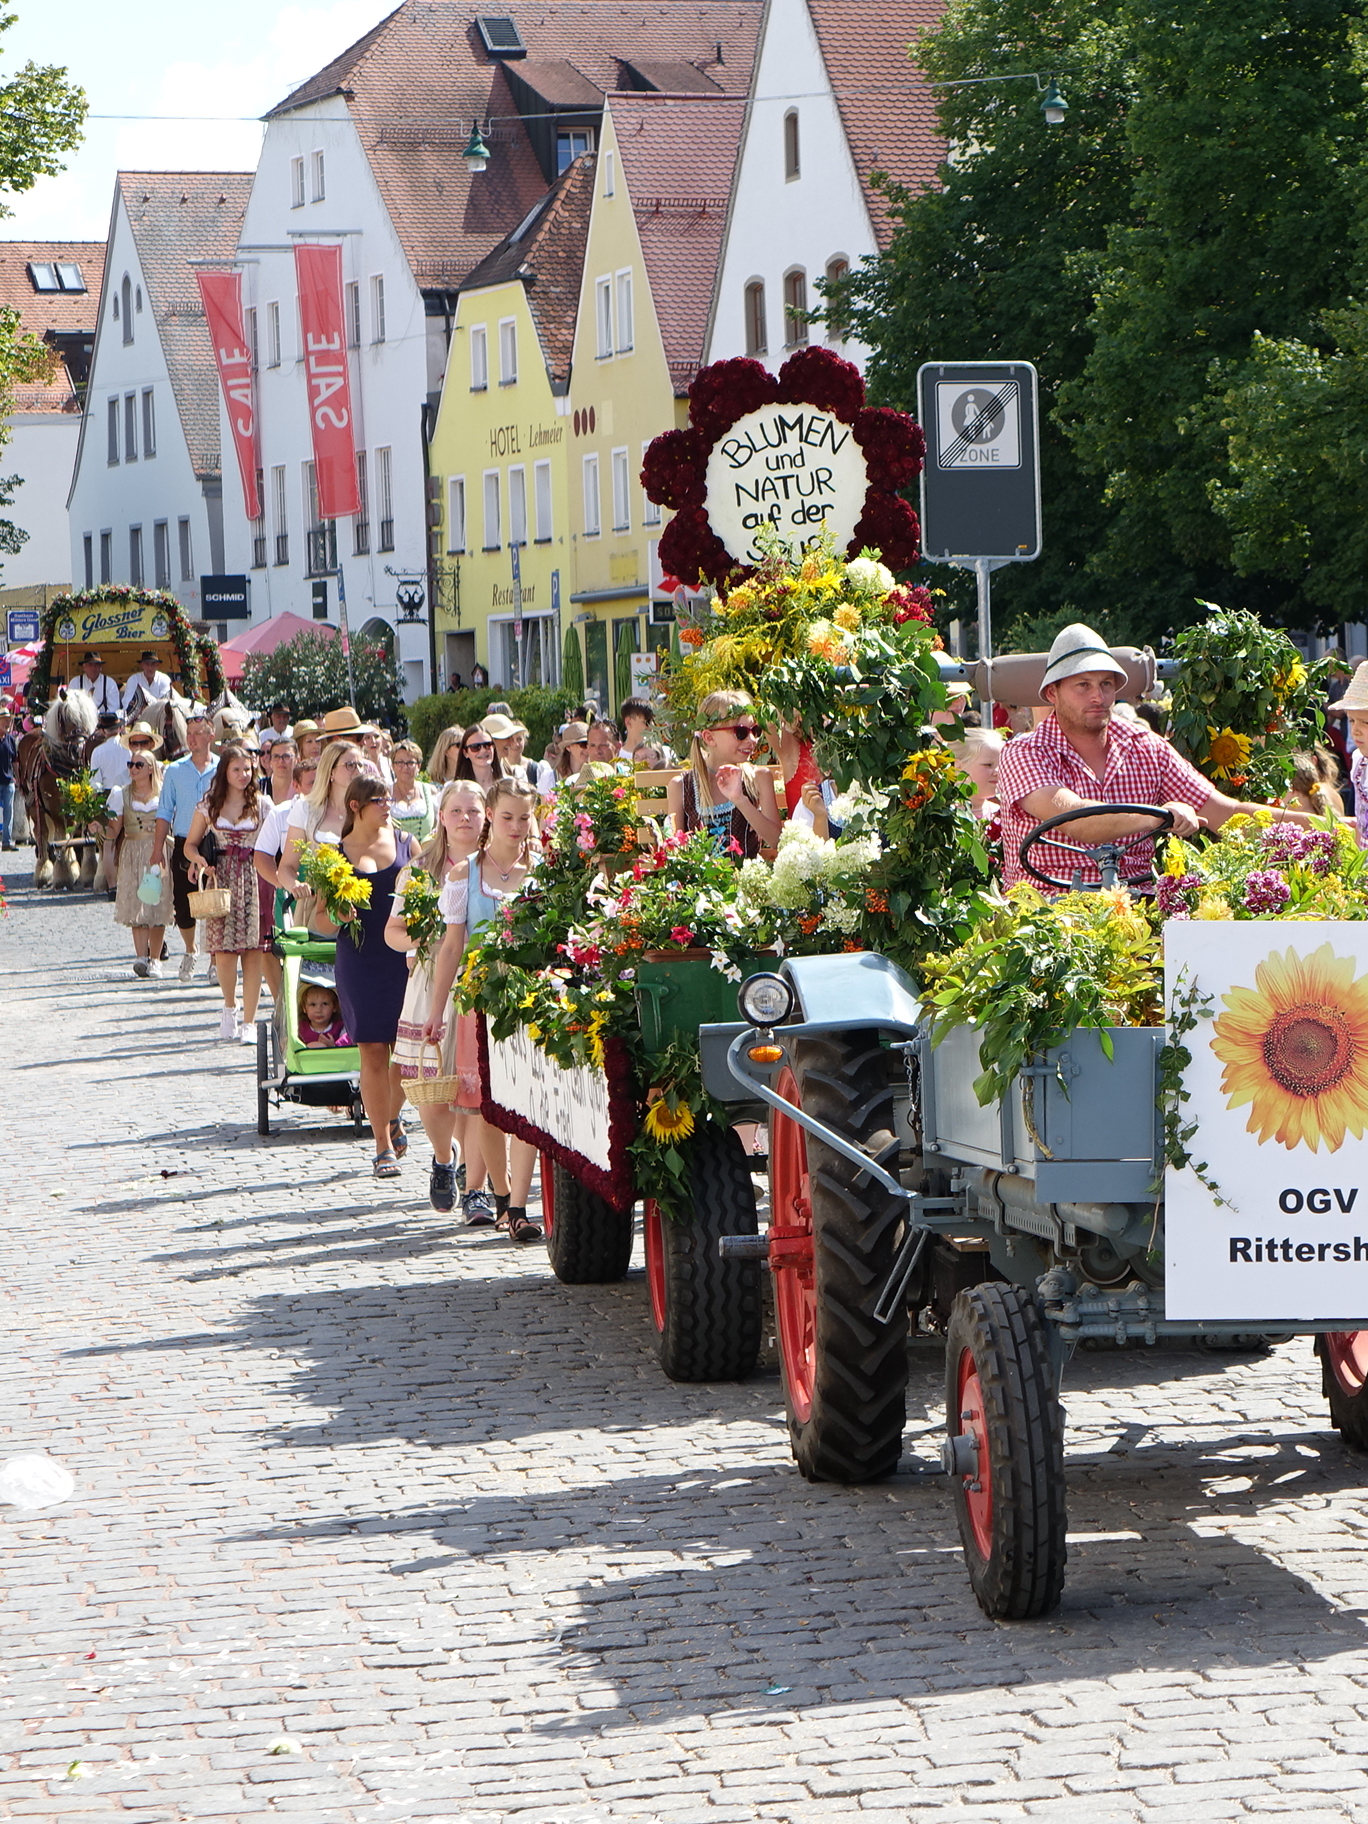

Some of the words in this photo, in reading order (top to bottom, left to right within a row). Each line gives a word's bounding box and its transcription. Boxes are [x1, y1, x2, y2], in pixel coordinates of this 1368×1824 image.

[490, 424, 521, 458] HOTEL
[529, 420, 563, 448] Lehmeier
[721, 412, 849, 469] BLUMEN
[766, 446, 805, 471] und
[959, 448, 1000, 462] ZONE
[735, 467, 836, 507] NATUR
[742, 503, 782, 531] auf
[791, 499, 835, 525] der
[205, 593, 245, 601] SCHMID
[492, 583, 535, 607] Restaant
[82, 608, 146, 640] Glossner
[116, 626, 146, 639] Bier
[1278, 1188, 1359, 1214] OGV
